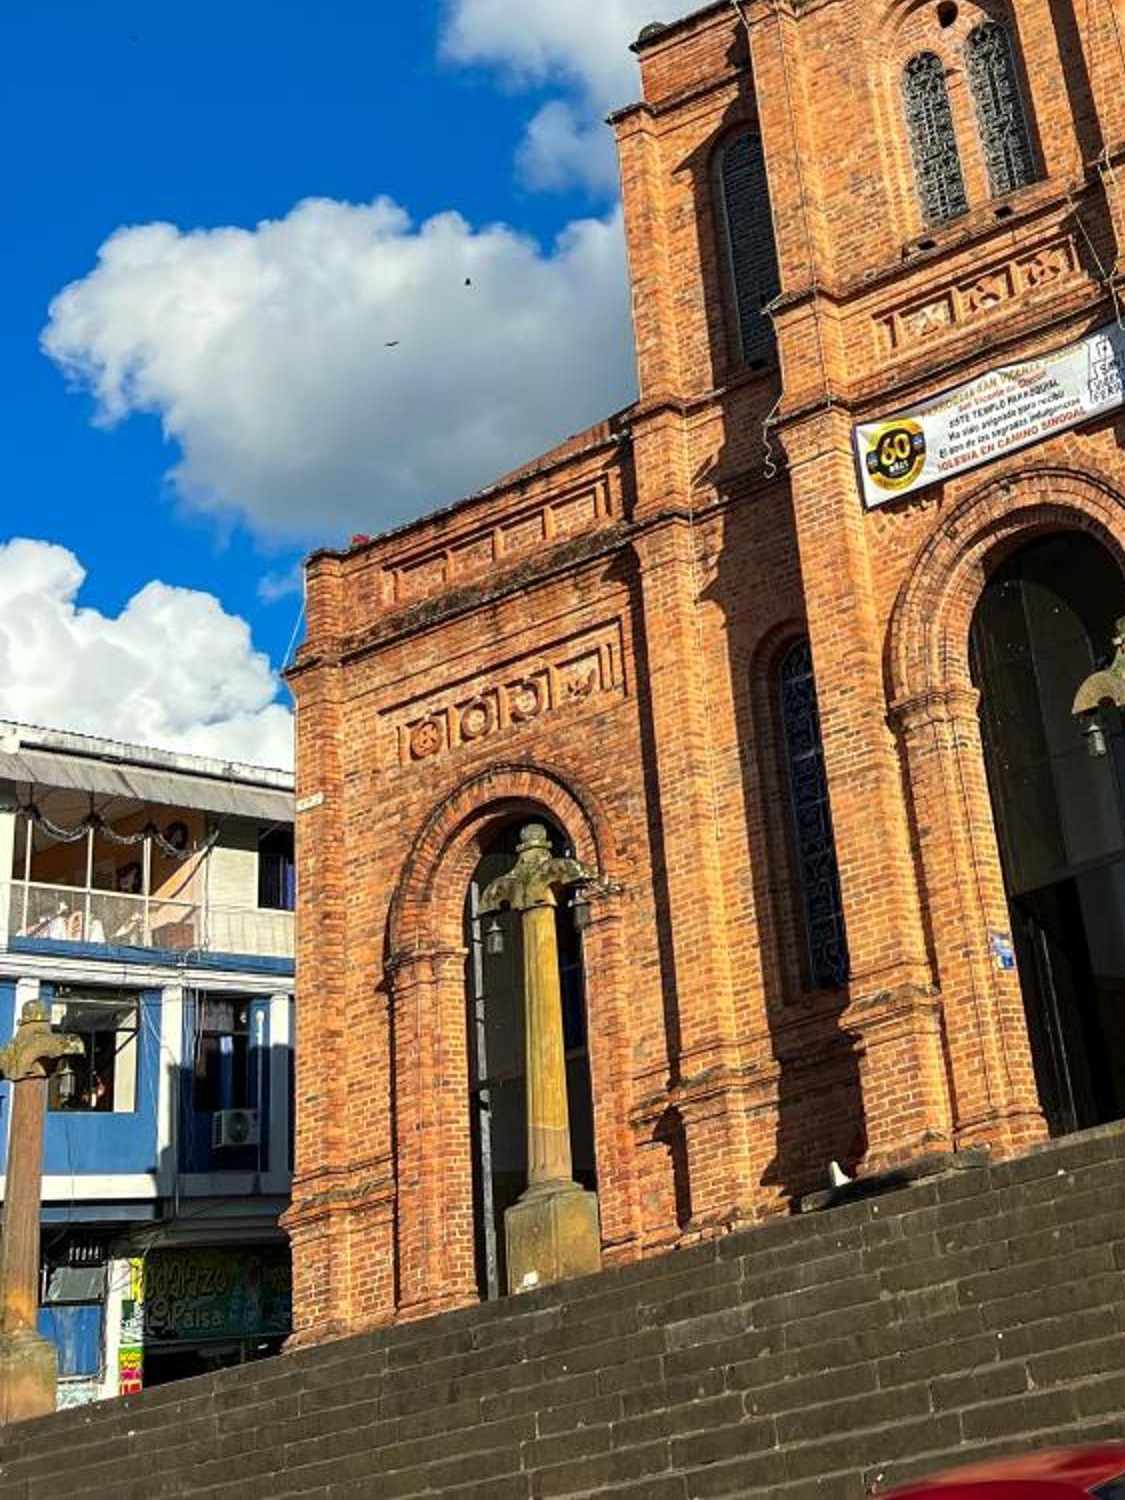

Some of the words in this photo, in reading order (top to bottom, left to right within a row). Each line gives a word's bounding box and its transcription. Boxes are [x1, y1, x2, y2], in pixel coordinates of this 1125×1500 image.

[976, 377, 997, 393] SAN
[949, 414, 970, 430] ESTE
[972, 399, 1007, 420] TEMPLO
[1007, 379, 1061, 406] PARROQUIAL
[880, 433, 911, 466] 60
[938, 449, 979, 473] IGLESIA
[980, 441, 995, 457] EN
[997, 424, 1039, 451] CAMINO
[1041, 405, 1087, 431] SINODAL
[171, 1303, 224, 1331] Paisa
